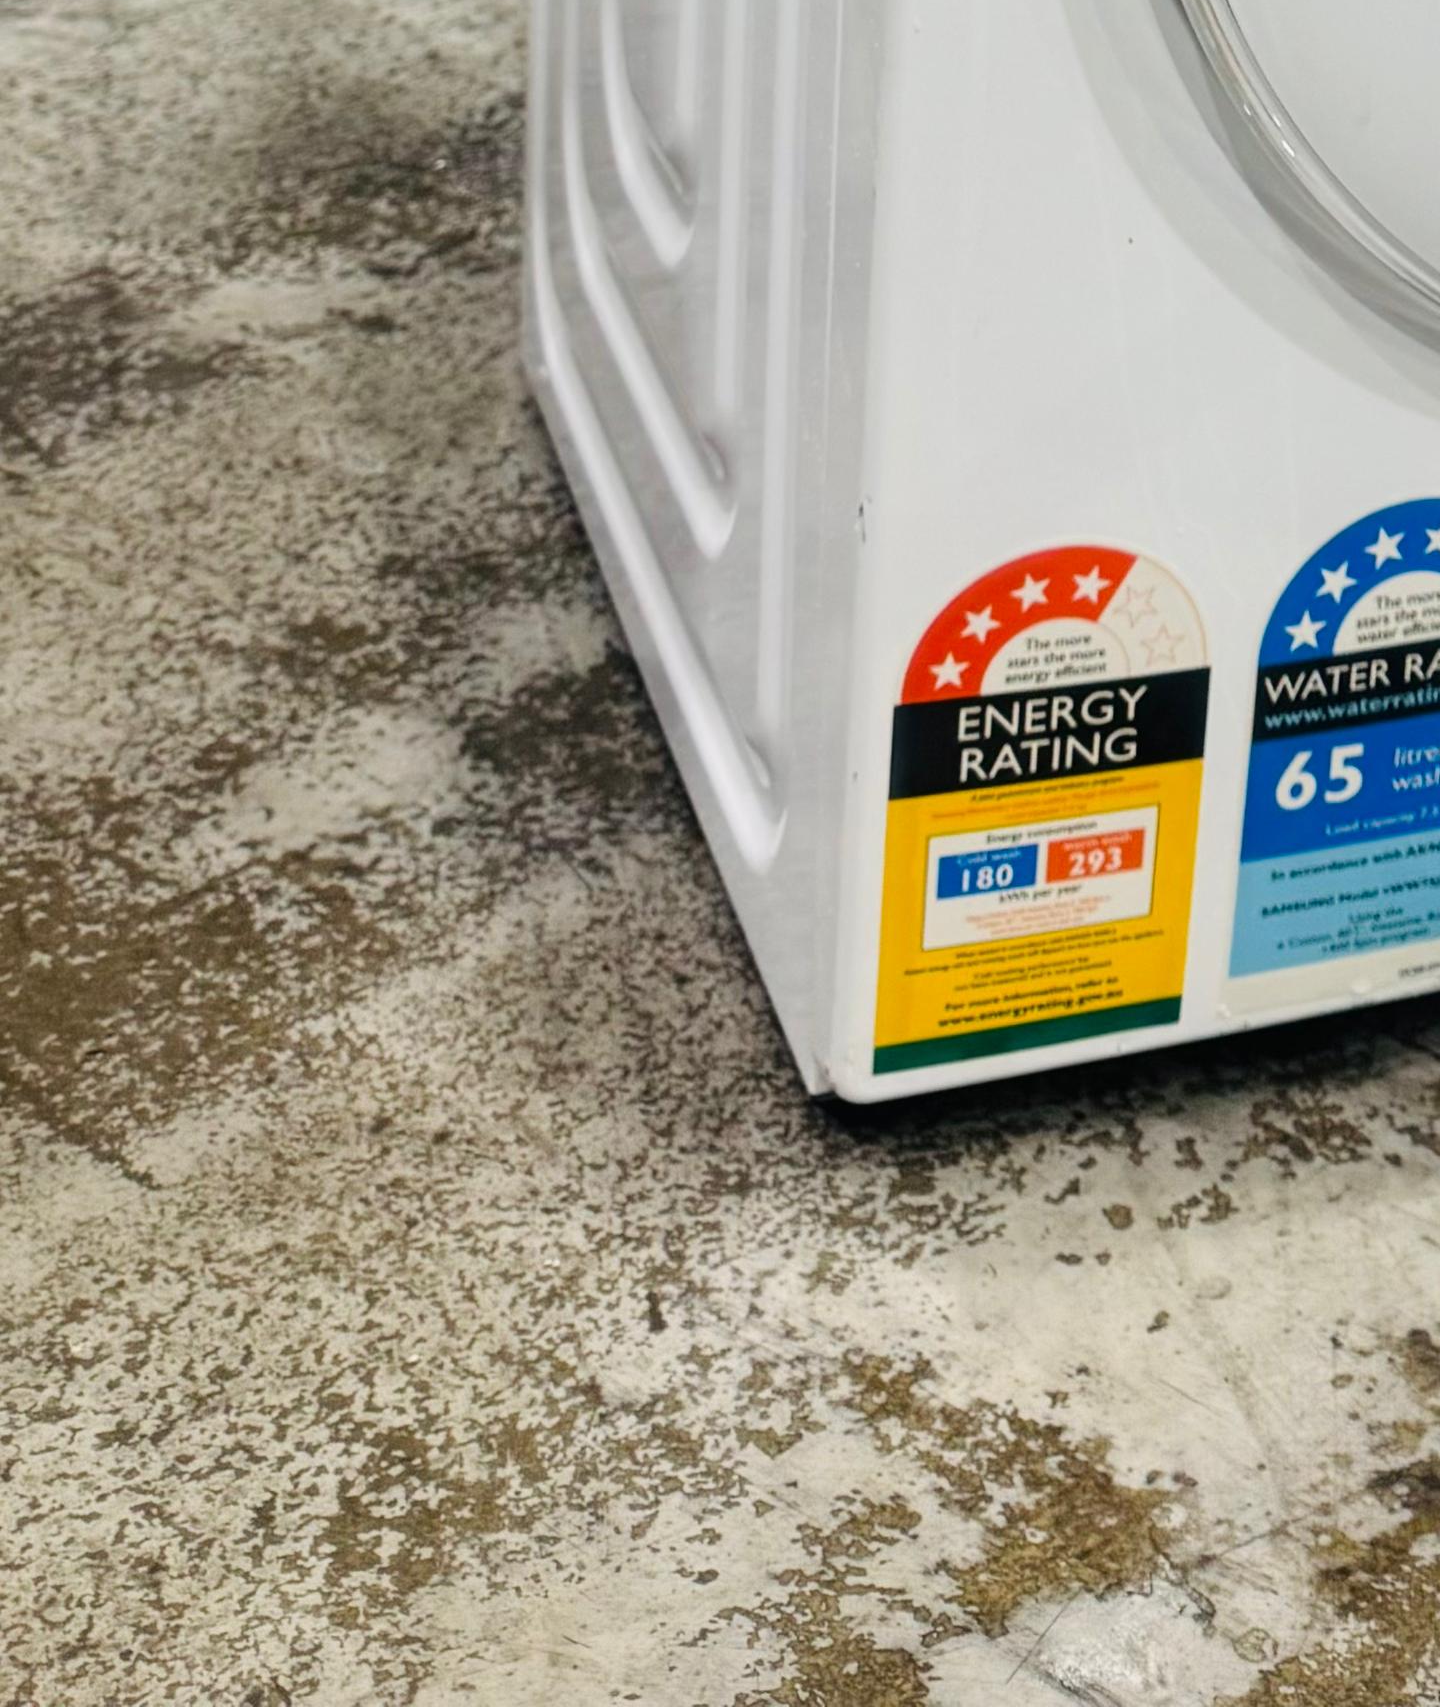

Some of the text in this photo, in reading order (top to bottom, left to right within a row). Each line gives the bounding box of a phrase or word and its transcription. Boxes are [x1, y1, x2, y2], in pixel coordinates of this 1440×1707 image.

[1376, 594, 1402, 609] The
[1357, 614, 1390, 629] stars
[1395, 609, 1418, 623] the
[1026, 635, 1092, 650] The more
[1357, 628, 1397, 644] water
[1007, 648, 1107, 669] stars the more
[1004, 662, 1107, 685] energy efficient
[1264, 658, 1391, 705] WATER
[957, 685, 1148, 743] ENERGY
[959, 727, 1138, 784] RATING
[1275, 742, 1365, 812] 65
[1068, 846, 1123, 878] 293
[962, 863, 1014, 893] 180
[999, 889, 1030, 904] kWh
[1032, 888, 1053, 902] per
